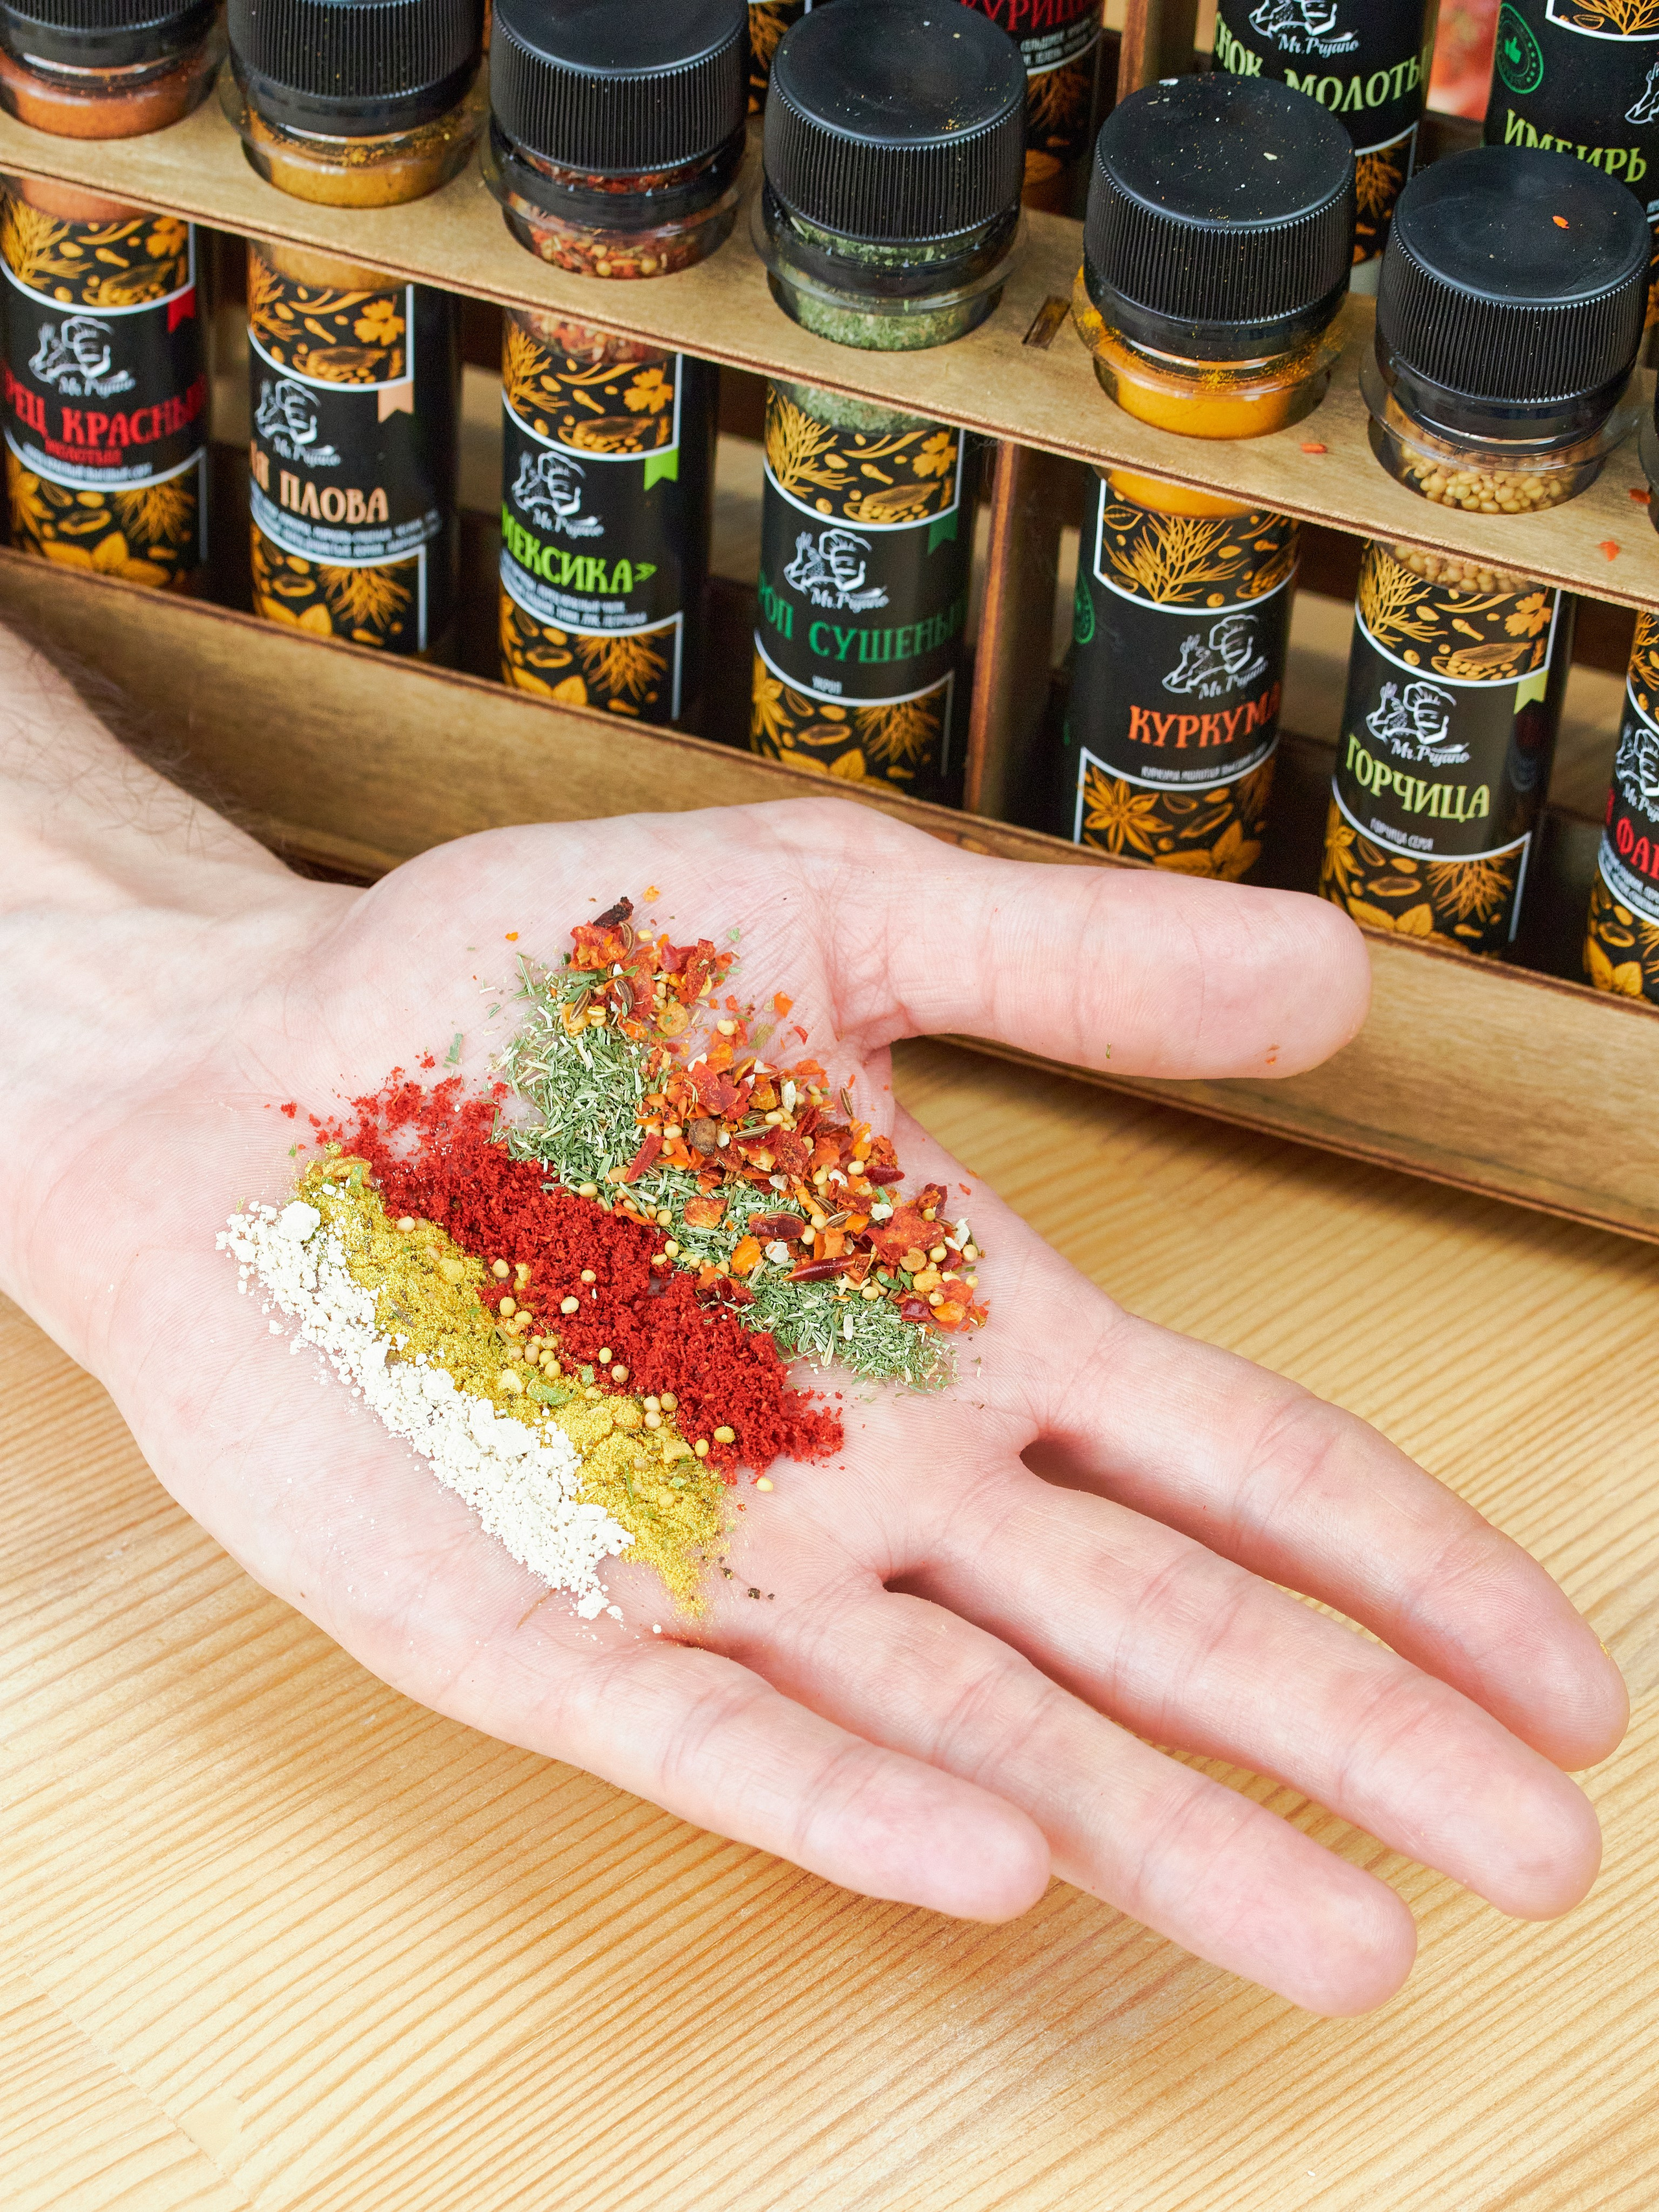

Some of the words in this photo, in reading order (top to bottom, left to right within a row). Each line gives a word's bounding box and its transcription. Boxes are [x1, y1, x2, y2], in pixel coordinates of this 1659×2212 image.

[1214, 11, 1264, 78] НОК
[280, 469, 389, 524] ПЛОВА
[1345, 733, 1491, 822] ГОРЧИЦА
